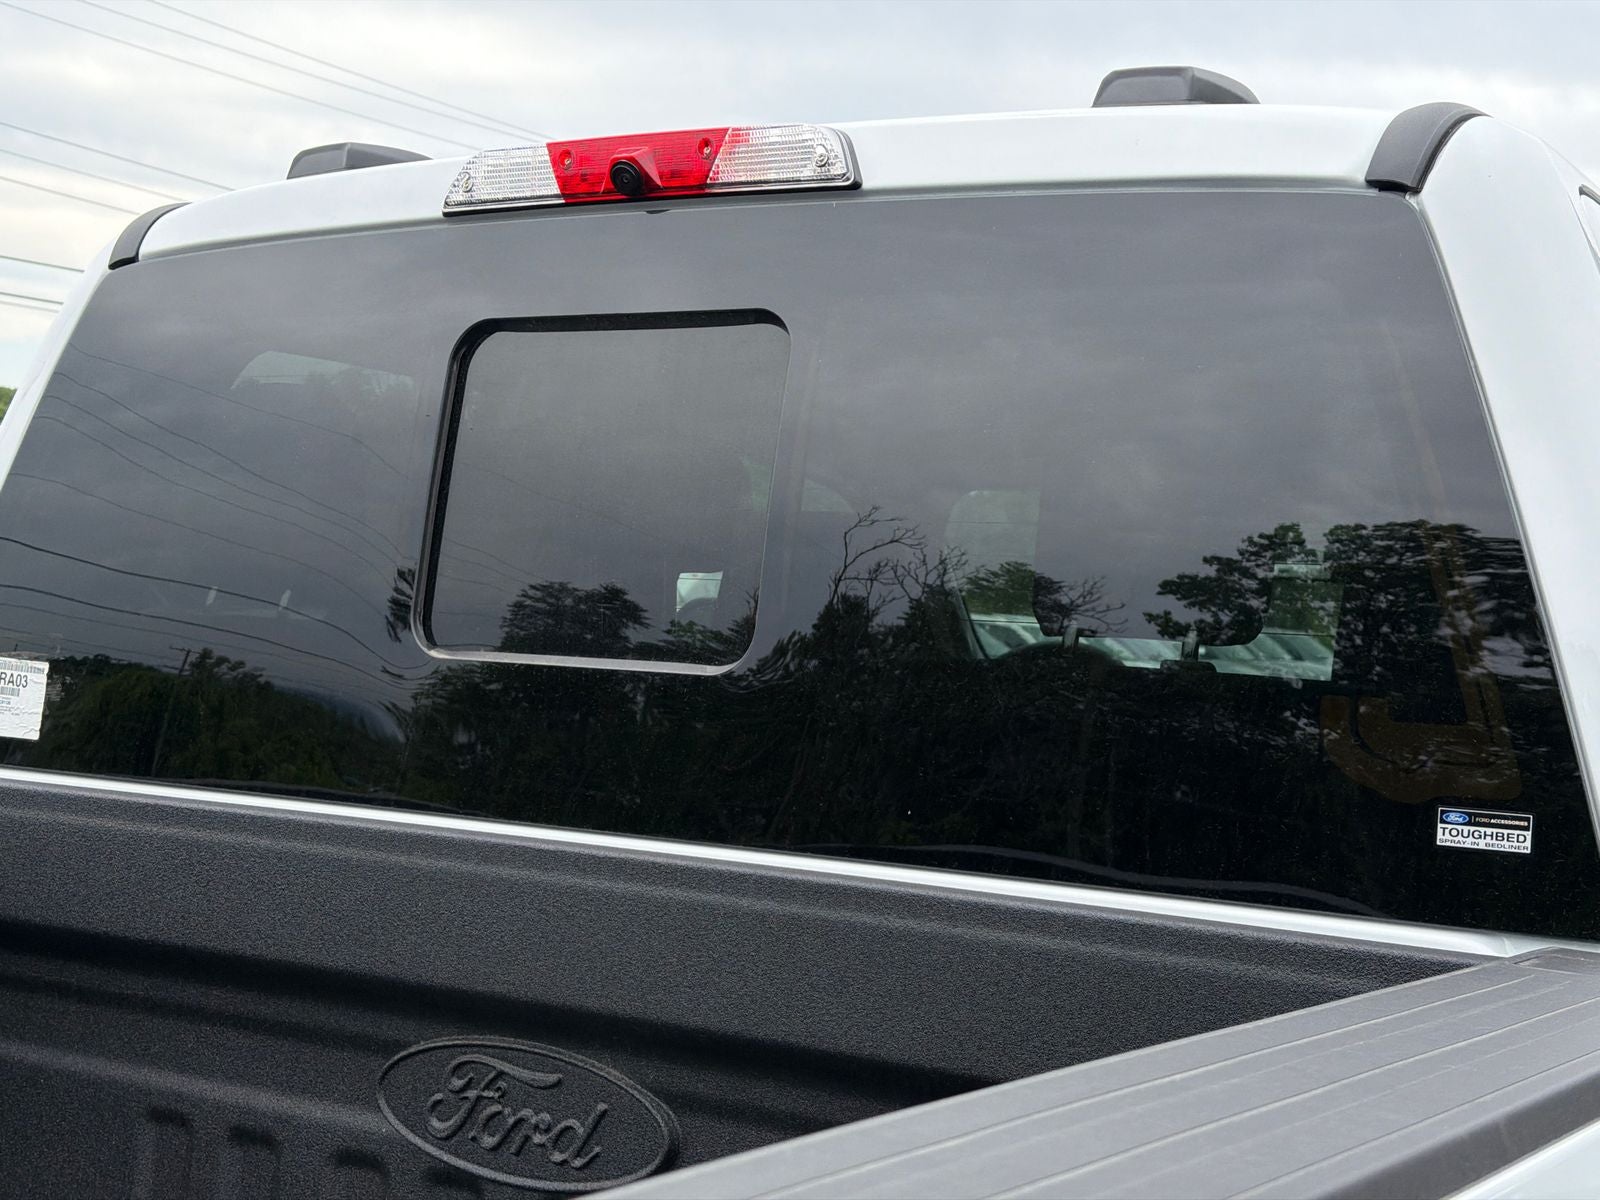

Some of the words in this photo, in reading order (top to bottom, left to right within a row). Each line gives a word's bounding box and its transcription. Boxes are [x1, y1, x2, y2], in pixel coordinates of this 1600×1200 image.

[1440, 827, 1527, 843] TOUGHBED
[1439, 838, 1479, 847] SPRAY-IN
[1485, 842, 1528, 851] BEDLINER
[426, 1054, 609, 1169] Ford
